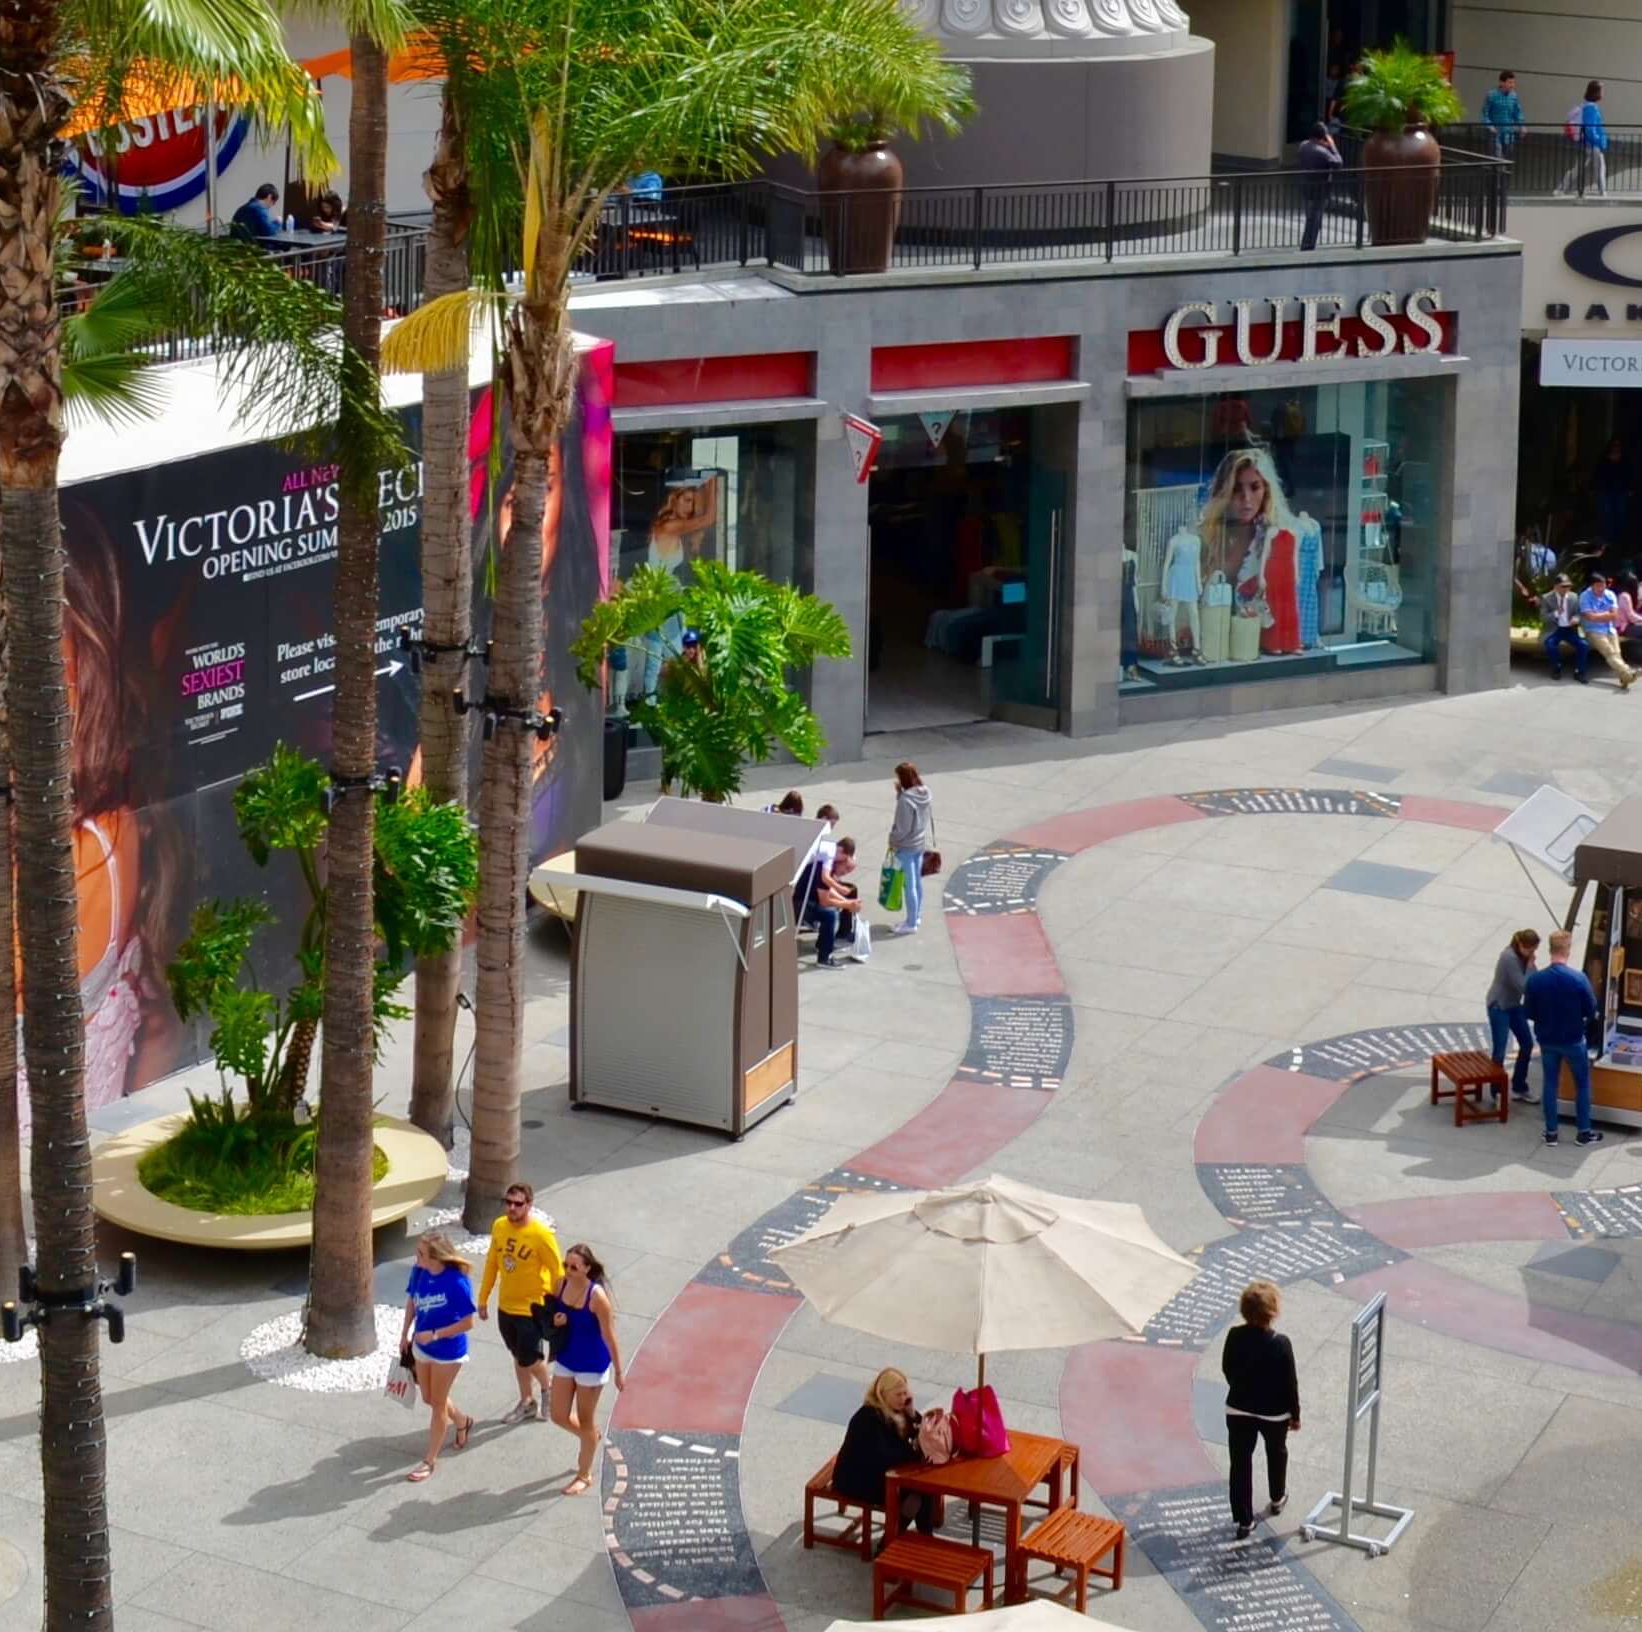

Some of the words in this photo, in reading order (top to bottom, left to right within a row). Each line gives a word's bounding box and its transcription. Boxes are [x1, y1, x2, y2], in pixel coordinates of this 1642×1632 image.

[1163, 287, 1445, 370] GUESS
[283, 471, 307, 491] ALL
[134, 483, 340, 566] VICTORIA'S
[202, 538, 293, 580] OPENING
[277, 641, 314, 662] Please
[374, 608, 425, 633] emporary
[182, 659, 245, 696] SEXIEST
[280, 665, 311, 684] store
[197, 683, 245, 710] BRANDS
